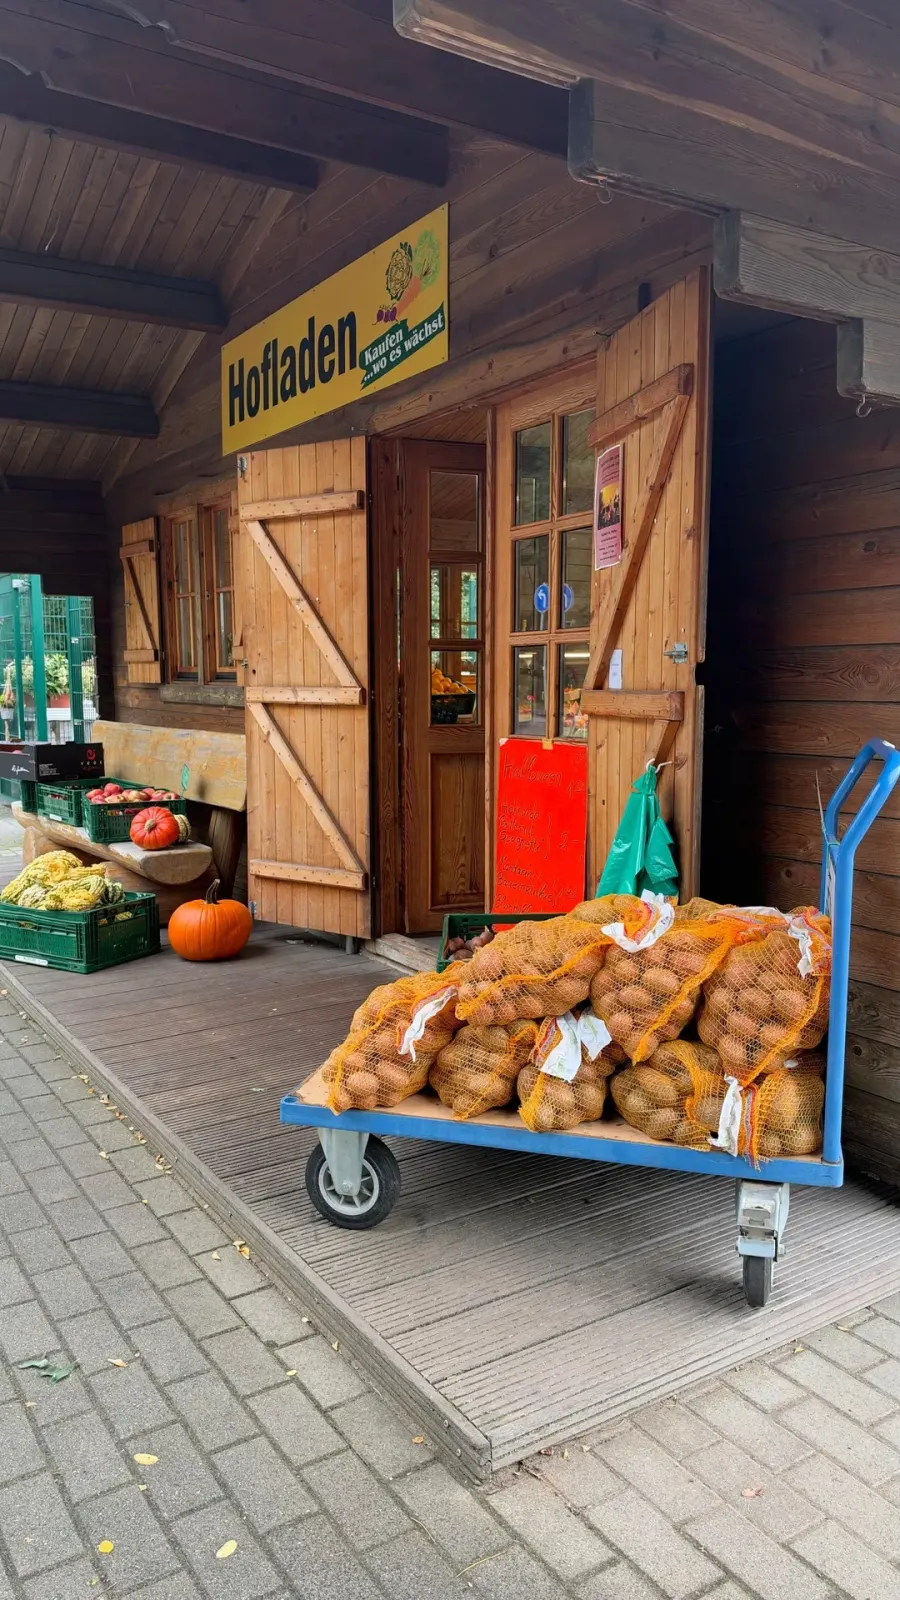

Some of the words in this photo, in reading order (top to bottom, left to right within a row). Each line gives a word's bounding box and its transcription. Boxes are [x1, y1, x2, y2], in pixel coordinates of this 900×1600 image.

[364, 328, 403, 366] Kaufen
[389, 345, 402, 363] es
[404, 313, 444, 350] wächst
[229, 311, 357, 427] Hofladen
